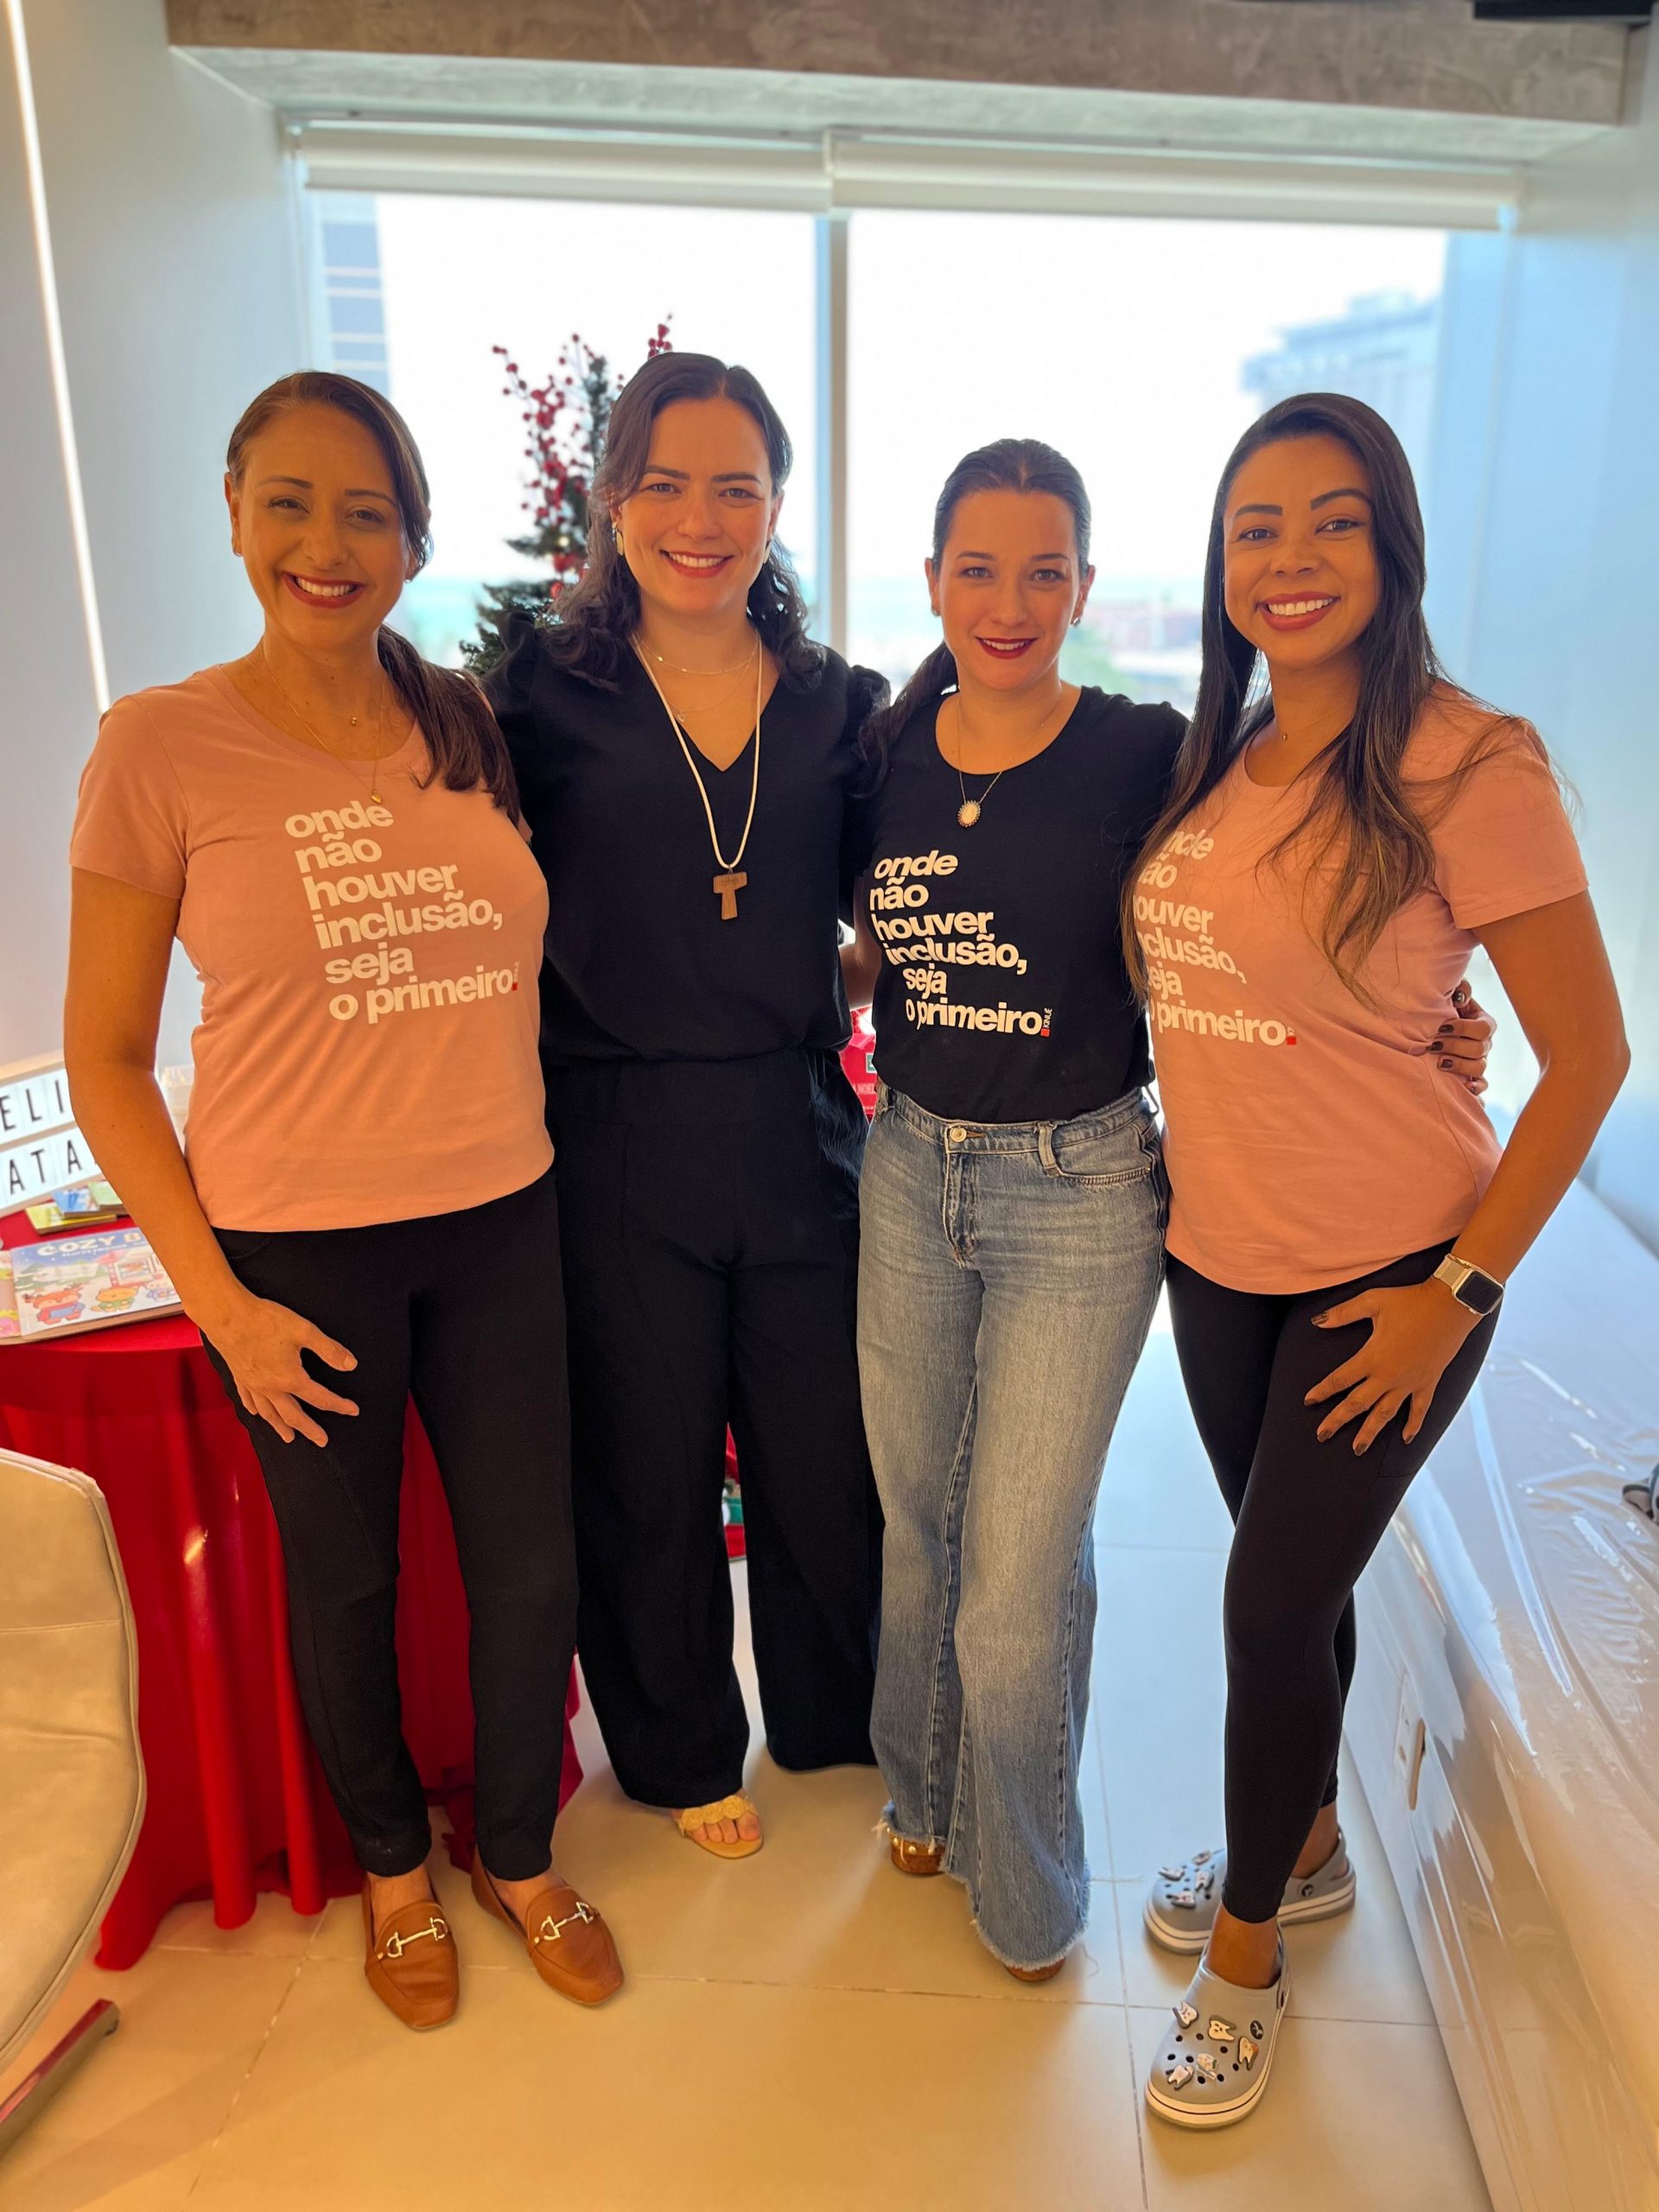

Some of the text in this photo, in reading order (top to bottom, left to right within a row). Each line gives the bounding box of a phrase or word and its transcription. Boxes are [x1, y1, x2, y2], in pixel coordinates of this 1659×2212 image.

[285, 800, 394, 838] onde
[295, 830, 383, 874] não
[1161, 829, 1215, 860] nde
[874, 849, 958, 880] onde
[1138, 851, 1178, 889] ão
[302, 864, 459, 911] houver
[869, 875, 930, 912] não
[312, 890, 503, 950] inclusão,
[871, 911, 994, 941] houver
[1133, 893, 1214, 936] ouver
[325, 942, 415, 985] seja
[882, 933, 1027, 976] inclusão,
[1136, 926, 1248, 984] clusão,
[902, 963, 947, 1000] seja
[1147, 960, 1184, 1001] eja
[328, 994, 359, 1020] o
[906, 999, 916, 1022] o
[10, 1139, 97, 1196] ATA
[36, 1235, 117, 1256] COZY
